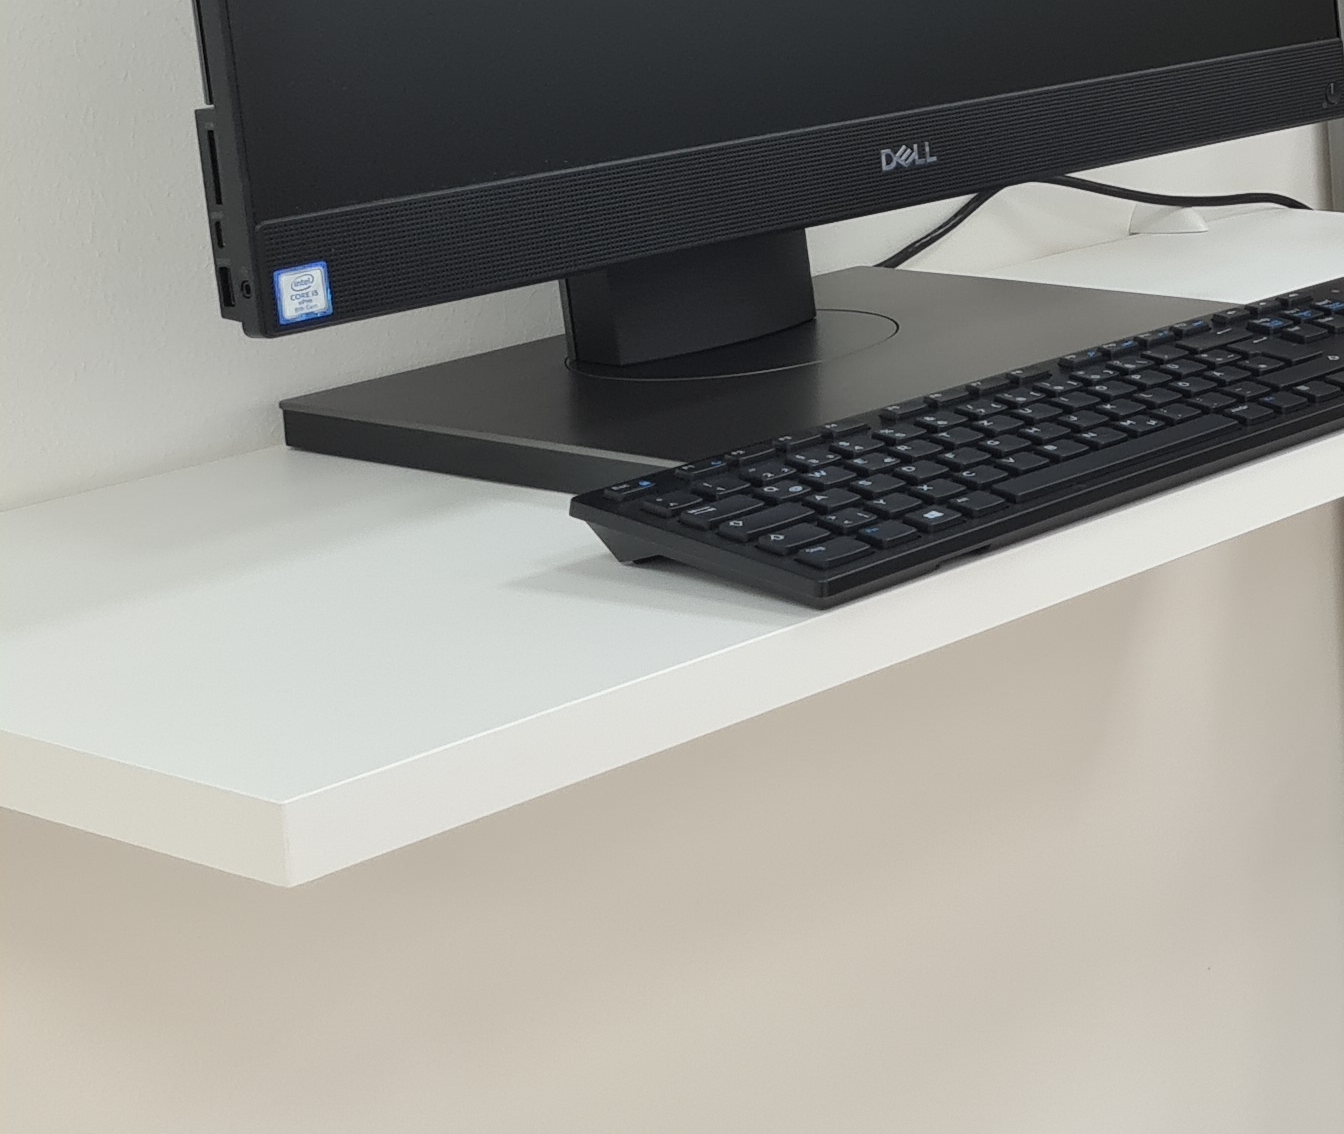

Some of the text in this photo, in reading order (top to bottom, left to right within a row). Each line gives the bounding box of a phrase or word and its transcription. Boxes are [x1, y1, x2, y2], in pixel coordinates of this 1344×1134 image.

[880, 141, 938, 172] DELL
[290, 289, 319, 301] CORE i5
